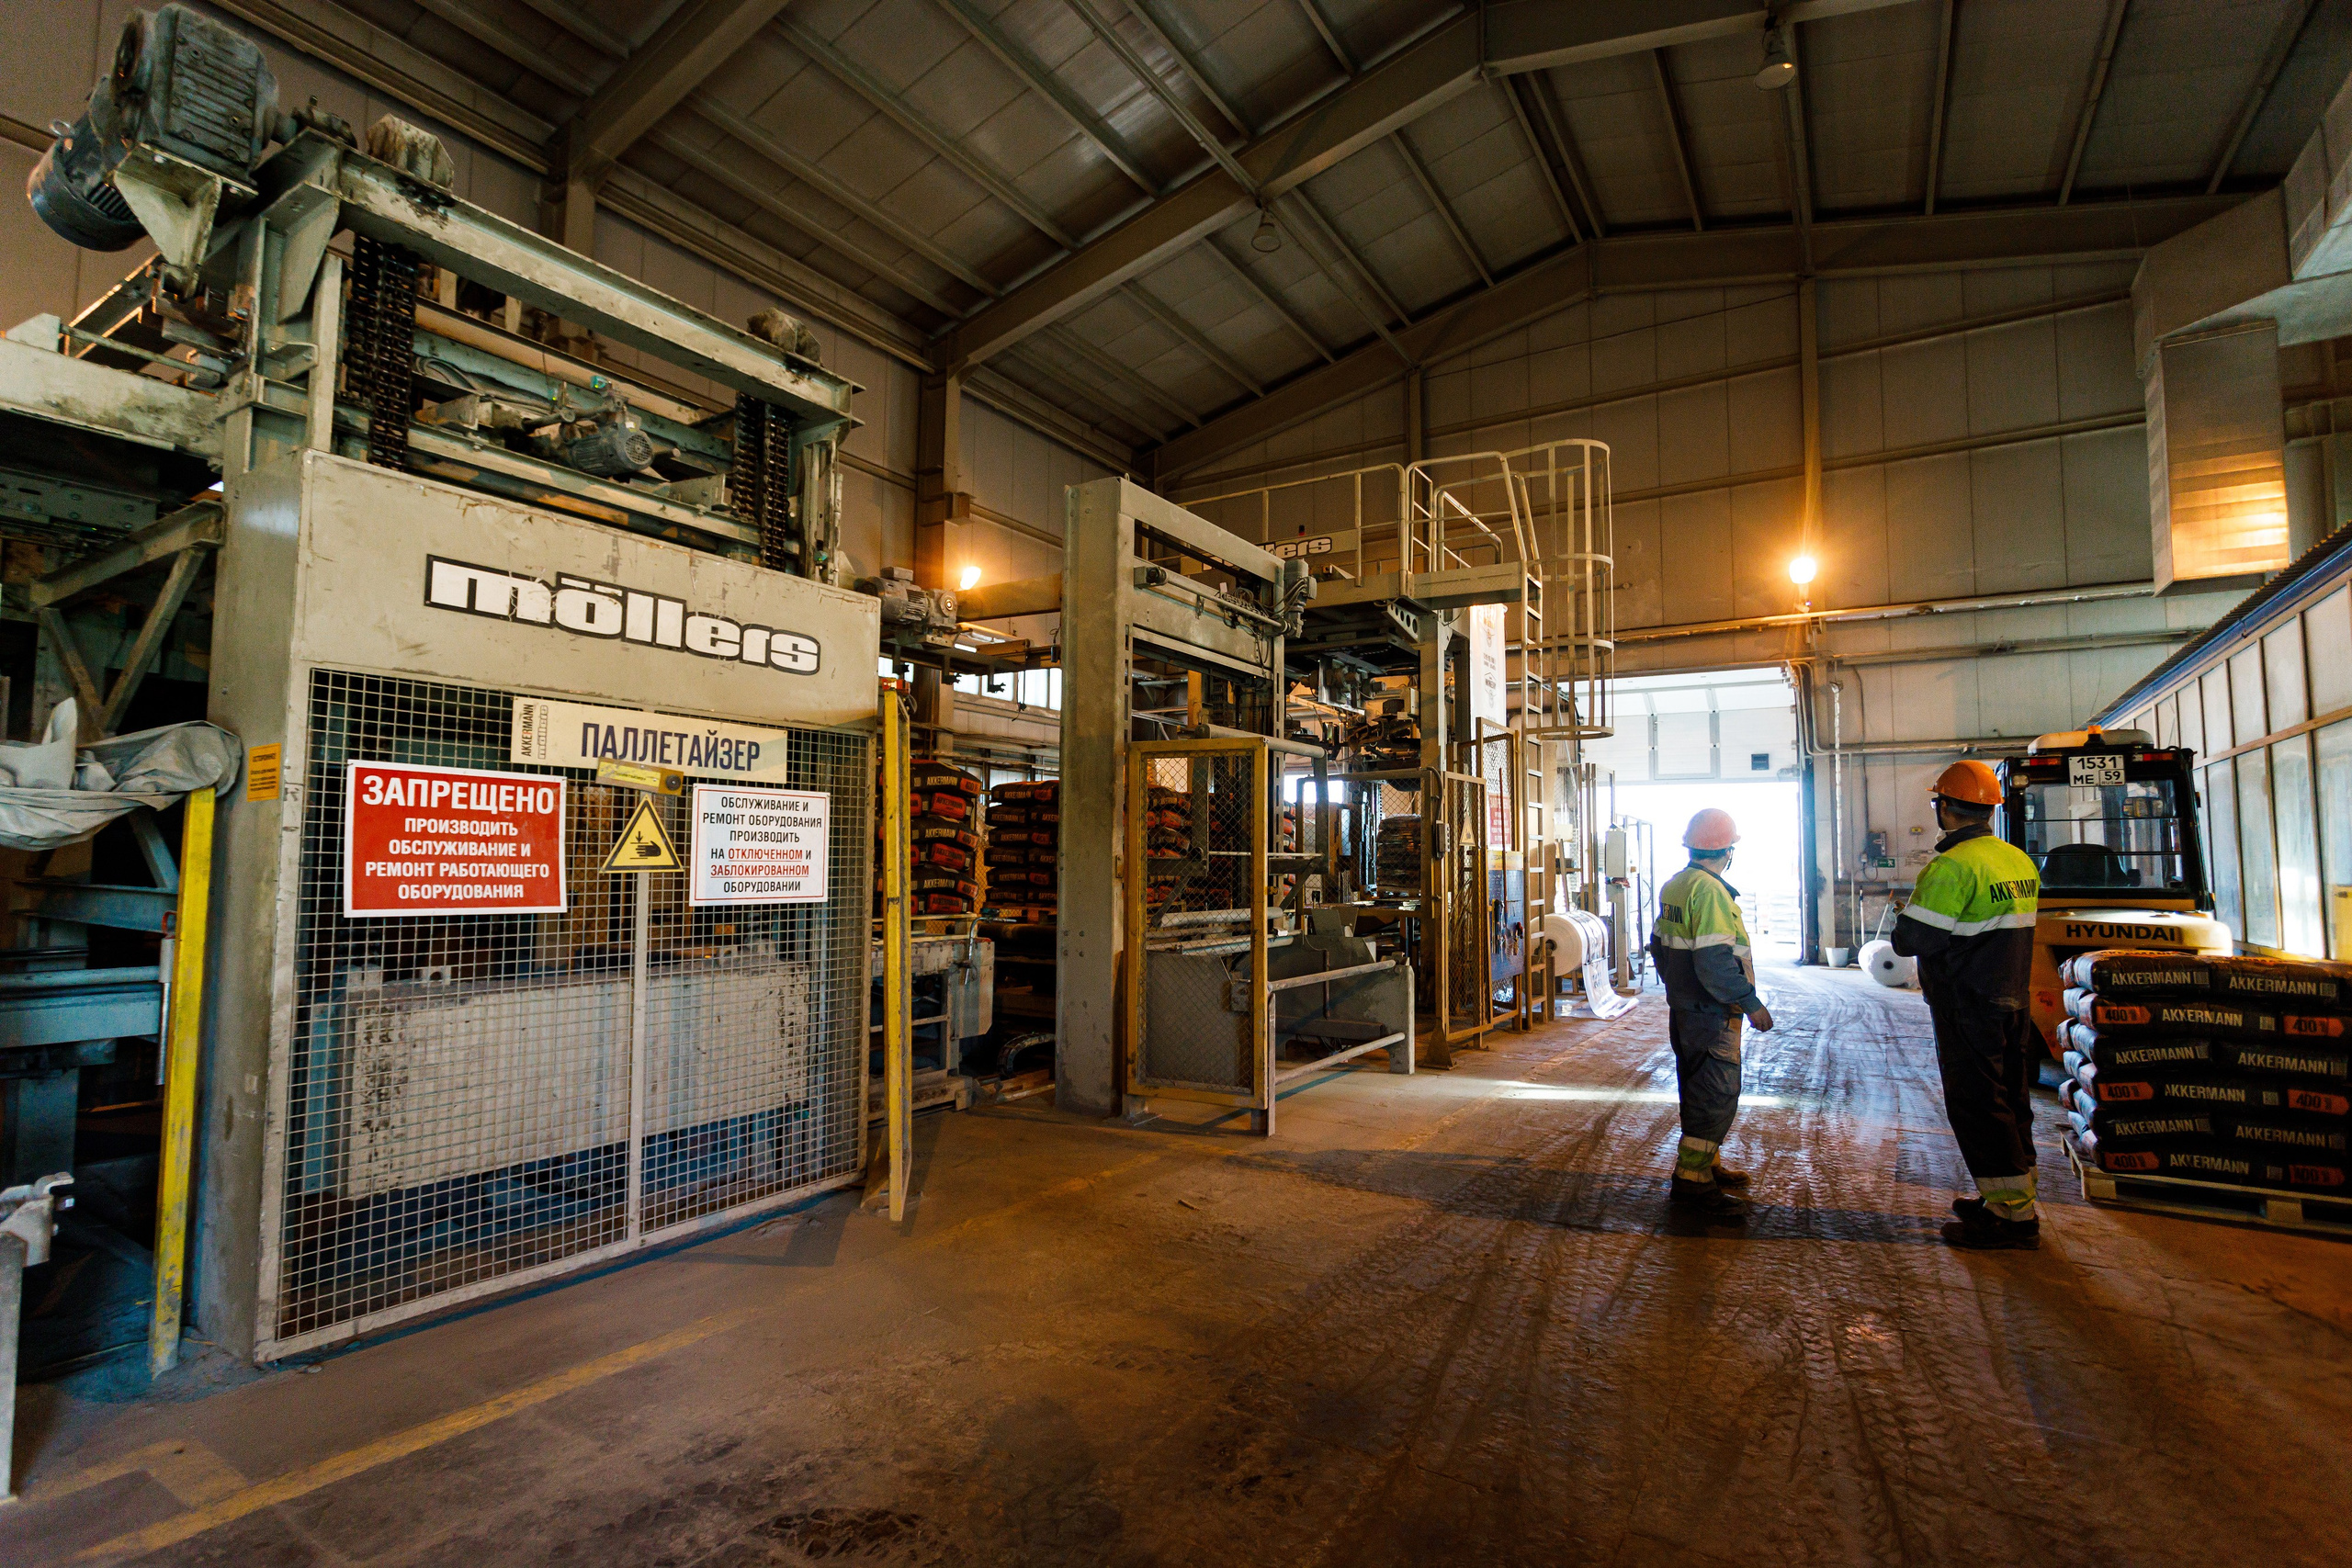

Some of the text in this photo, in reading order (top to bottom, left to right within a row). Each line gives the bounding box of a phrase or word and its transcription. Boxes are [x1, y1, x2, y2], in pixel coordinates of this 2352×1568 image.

[424, 554, 820, 675] möllers
[521, 704, 534, 757] AKKERMANN
[581, 721, 761, 772] ПАЛЛЕТАЙЗЕР
[2077, 756, 2117, 770] 1531
[2074, 771, 2121, 784] ME 59
[362, 774, 555, 815] ЗАПРЕЩЕНО
[720, 795, 809, 812] ОБСЛУЖИВАНИЕ И
[404, 818, 519, 837] ПРОИЗВОДИТЬ
[702, 812, 822, 829] РЕМОНТ ОБОРУДОВАНИЯ
[729, 829, 800, 844] ПРОИЗВОДИТЬ
[389, 839, 531, 857] ОБСЛУЖИВАНИЕ И
[710, 848, 811, 860] НА ОТКЛЮЧЕННОМ И
[365, 862, 550, 879] РЕМОНТ РАБОТАЮЩЕГО
[710, 864, 809, 876] ЗАБЛОКИРОВАННОМ
[397, 884, 525, 901] ОБОРУДОВАНИЯ
[723, 880, 801, 894] ОБОРУДОВАНИИ
[2066, 924, 2176, 942] HYUNDAI
[2112, 971, 2191, 986] AKKERMANN
[2229, 976, 2316, 996] AKKERMANN
[2105, 1009, 2127, 1021] 400
[2162, 1009, 2243, 1027] AKKERMANN
[2292, 1019, 2317, 1032] 400
[2116, 1046, 2195, 1065] AKKERMANN
[2237, 1052, 2327, 1074] AKKERMANN
[2108, 1086, 2131, 1099] 400
[2165, 1084, 2245, 1102] AKKERMANN
[2296, 1094, 2321, 1109] 400
[2116, 1119, 2194, 1136] AKKERMANN
[2236, 1125, 2325, 1148] AKKERMANN
[2113, 1155, 2137, 1168] 400
[2170, 1154, 2249, 1175] AKKERMANN
